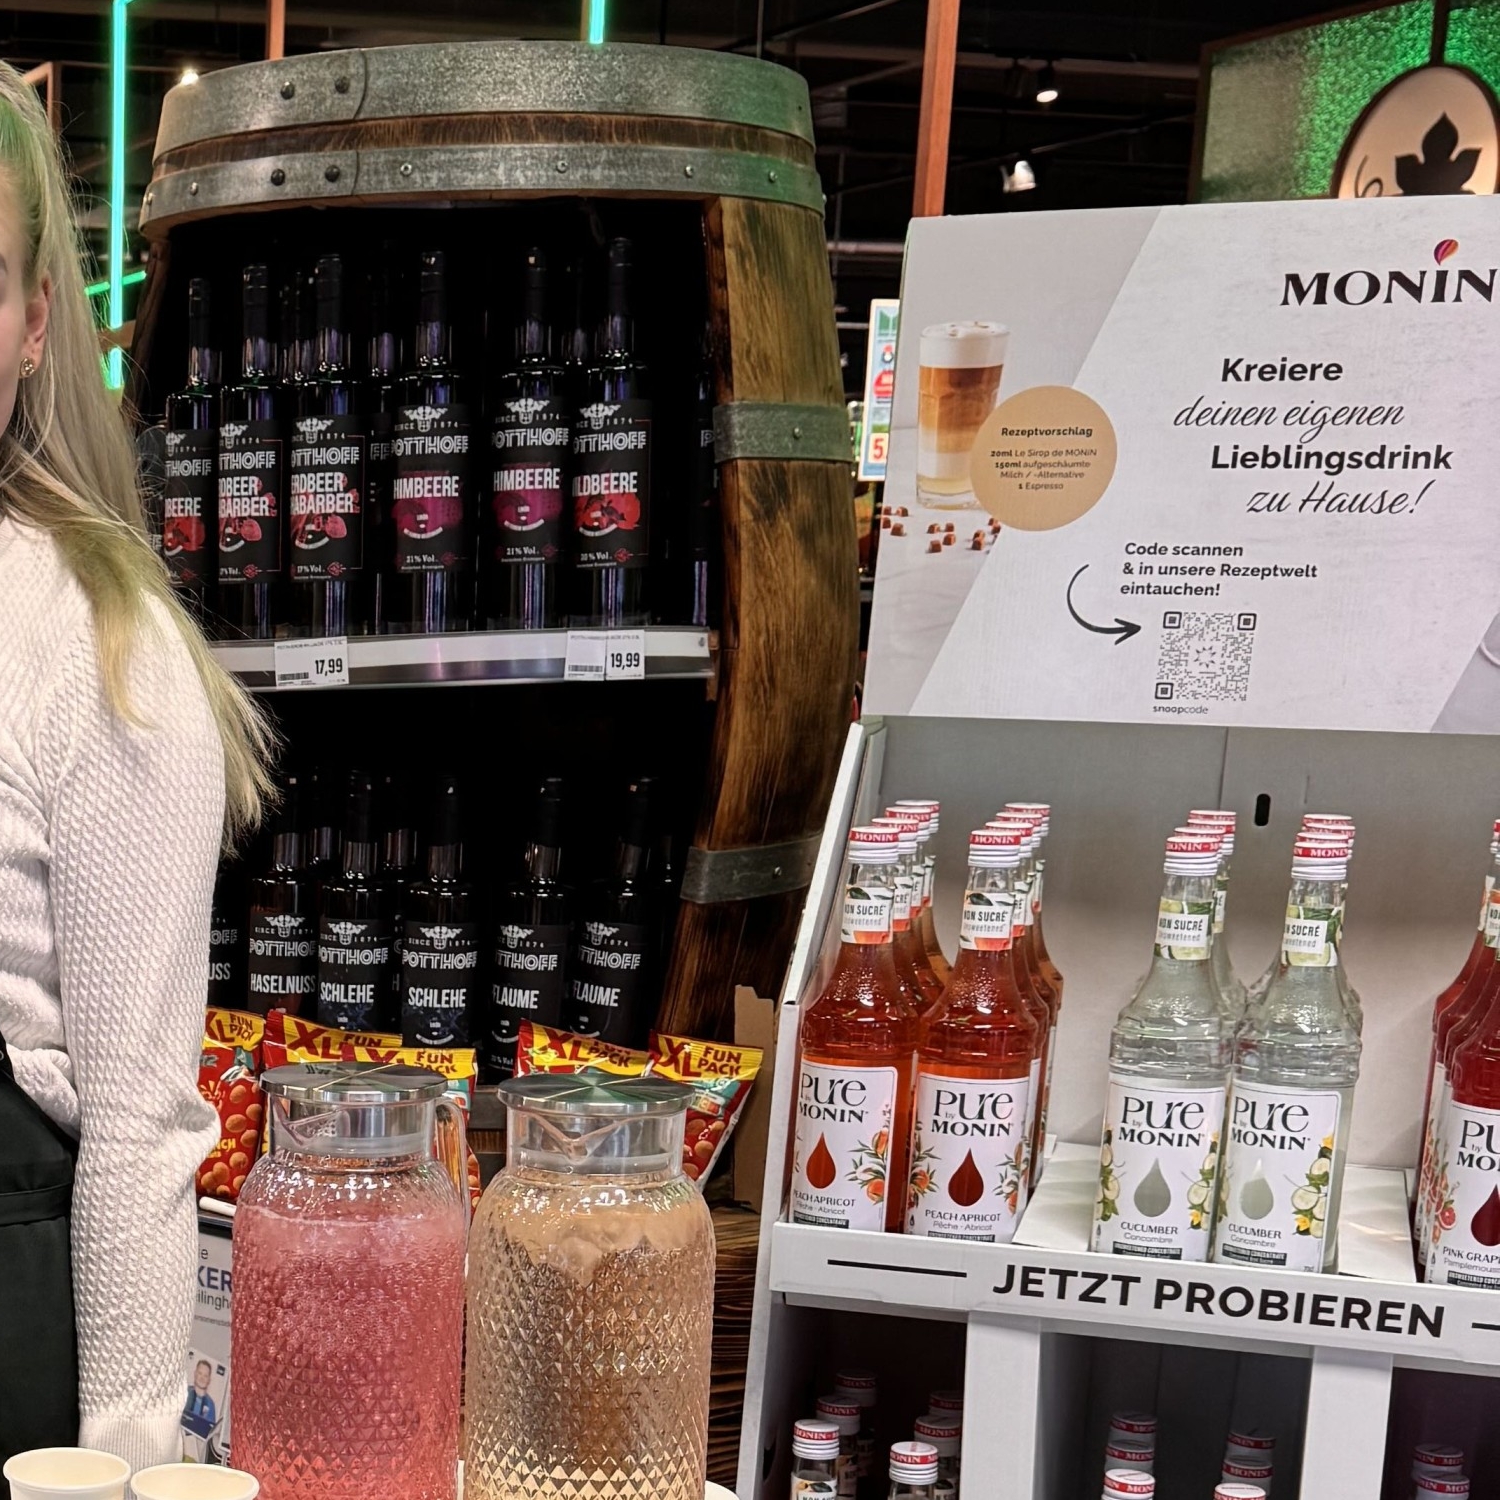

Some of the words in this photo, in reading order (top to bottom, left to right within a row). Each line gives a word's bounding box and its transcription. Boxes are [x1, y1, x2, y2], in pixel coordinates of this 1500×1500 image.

[1280, 269, 1498, 306] MONIN
[1221, 357, 1343, 381] Kreiere
[1173, 395, 1277, 426] deinen
[1283, 401, 1404, 444] eigenen
[1001, 427, 1092, 438] Rezeptvorschlag
[1028, 449, 1049, 457] Sirop
[1211, 445, 1453, 476] Lieblingsdrink
[1023, 461, 1090, 469] aufgeschäumte
[394, 475, 459, 499] HIMBEERE
[494, 468, 560, 492] HIMBEERE
[1247, 490, 1291, 513] zu
[1299, 479, 1436, 514] Hause!
[1125, 543, 1168, 555] Code
[1172, 545, 1243, 556] scannen
[1123, 563, 1134, 574] &
[1139, 563, 1153, 575] in
[1158, 565, 1215, 576] unsere
[1220, 564, 1318, 580] Rezeptwelt
[1120, 583, 1220, 596] eintauchen!
[315, 658, 342, 676] 17,99
[611, 653, 640, 670] 19,99
[855, 832, 893, 841] MONIN
[975, 835, 1015, 844] MONIN
[1174, 919, 1203, 931] SUCRÉ
[1292, 924, 1320, 936] SUCRÉ
[402, 949, 478, 970] POTTHOFF
[250, 973, 316, 994] HASELNUSS
[320, 981, 375, 1004] SCHLEHE
[408, 987, 467, 1009] SCHLEHE
[229, 1013, 253, 1028] FUN
[542, 1026, 586, 1062] XL
[416, 1051, 454, 1064] FUN
[658, 1037, 701, 1077] XL
[703, 1046, 742, 1065] FUN
[698, 1057, 742, 1076] PACK
[801, 1073, 867, 1106] Pure
[934, 1089, 1013, 1121] Pure
[1121, 1096, 1204, 1131] Pure
[1233, 1096, 1309, 1133] Pure
[931, 1119, 1013, 1137] MONIN
[1118, 1127, 1202, 1147] MONIN
[1231, 1127, 1305, 1150] MONIN
[813, 1195, 855, 1207] APRICOT
[926, 1209, 957, 1221] PEACH
[960, 1213, 1001, 1222] APRICOT
[933, 1221, 957, 1230] Pêche
[1121, 1221, 1178, 1235] CUCUMBER
[1229, 1223, 1282, 1239] CUCUMBER
[1124, 1233, 1173, 1244] Concombre
[1231, 1235, 1276, 1247] Concombre
[1443, 1246, 1464, 1259] PINK
[992, 1264, 1141, 1306] JETZT
[1154, 1278, 1445, 1338] PROBIEREN
